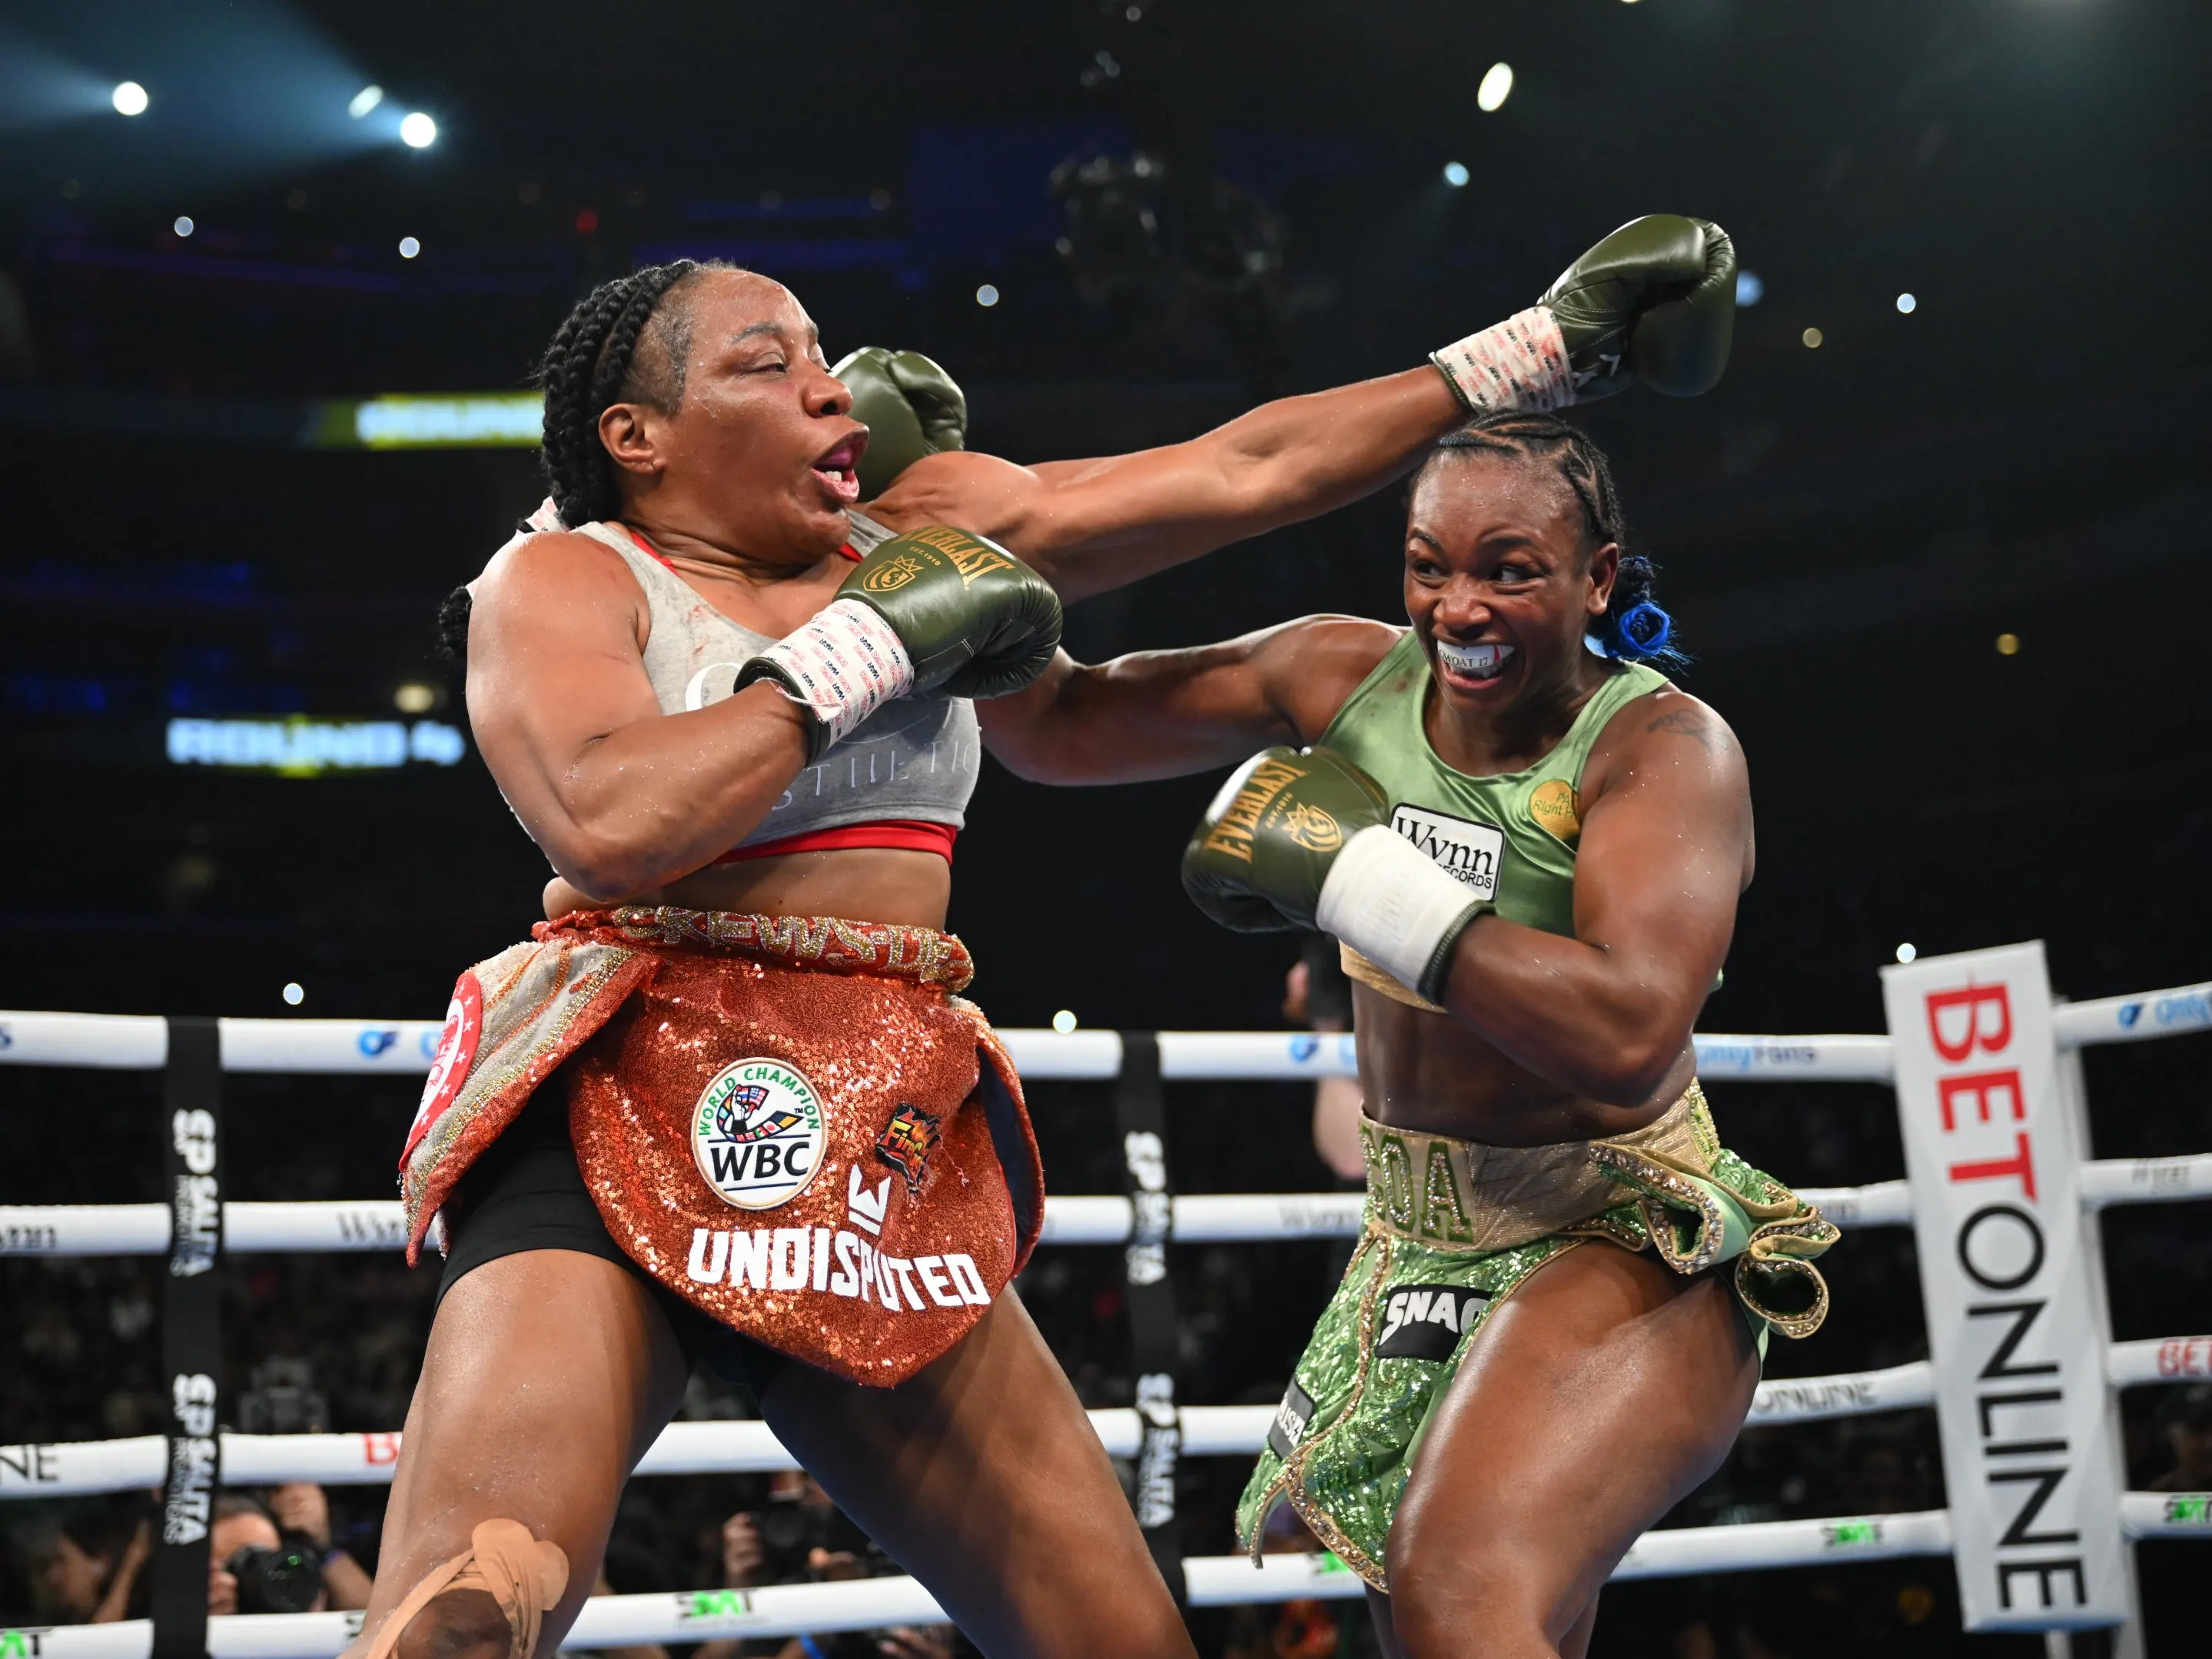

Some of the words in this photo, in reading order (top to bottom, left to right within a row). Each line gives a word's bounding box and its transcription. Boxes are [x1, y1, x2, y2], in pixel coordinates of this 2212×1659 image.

[1478, 657, 1488, 667] 17
[1205, 758, 1309, 864] EVERLAST
[1397, 816, 1494, 876] Wynn
[698, 1076, 737, 1135] WORLD
[743, 1066, 820, 1130] CHAMPION
[710, 1141, 810, 1182] WBC
[688, 1228, 991, 1312] UNDISPUTED
[177, 1438, 216, 1545] SALITA
